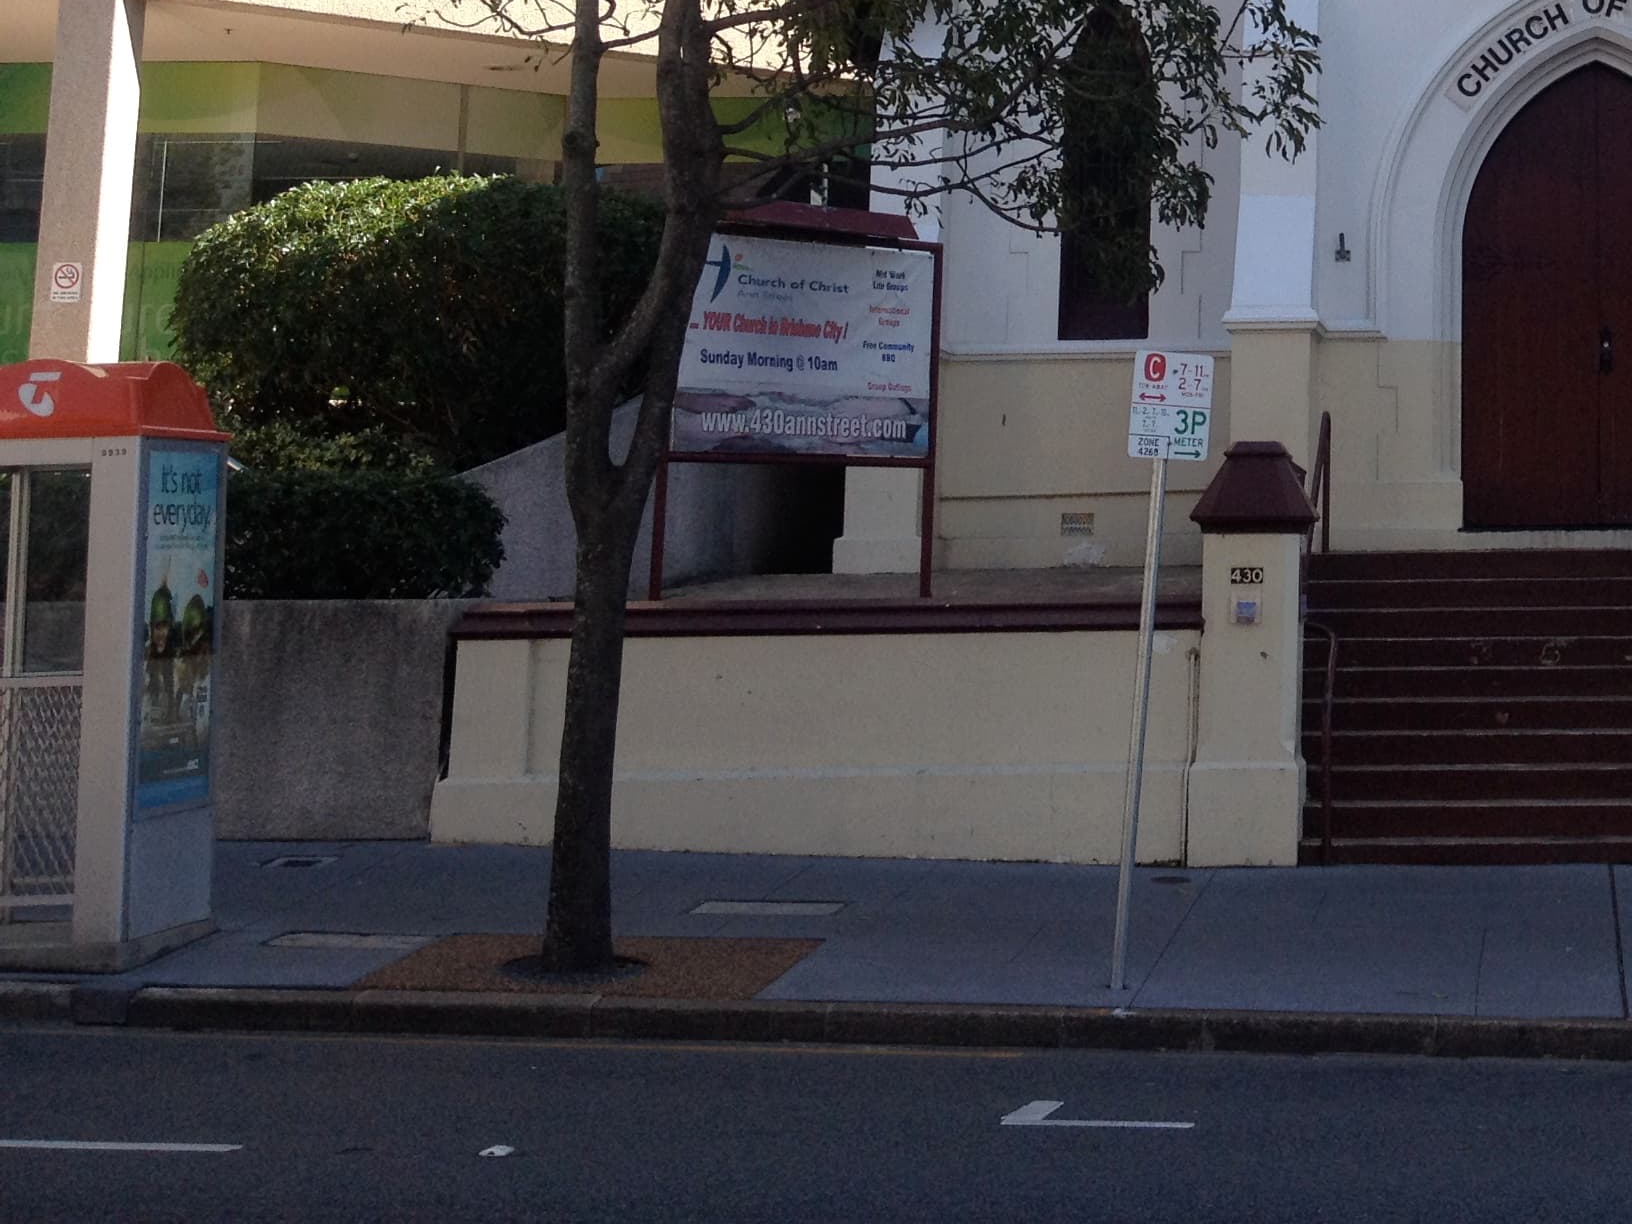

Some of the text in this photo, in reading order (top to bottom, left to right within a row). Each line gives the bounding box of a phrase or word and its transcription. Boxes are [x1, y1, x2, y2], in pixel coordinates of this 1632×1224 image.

[1456, 3, 1570, 97] CHURCH
[738, 274, 849, 294] Church of Christ
[703, 311, 732, 332] YOUR
[734, 313, 767, 334] Church
[824, 320, 843, 344] City
[863, 340, 914, 354] Free Community
[700, 349, 838, 372] Sunday Morning @ 10am
[1149, 357, 1161, 379] C
[702, 408, 907, 439] www.430annstreet.com
[1174, 409, 1207, 435] 3P
[1138, 437, 1159, 447] ZONE
[1174, 437, 1204, 447] METER
[161, 463, 203, 495] It's not
[1231, 568, 1263, 583] 430
